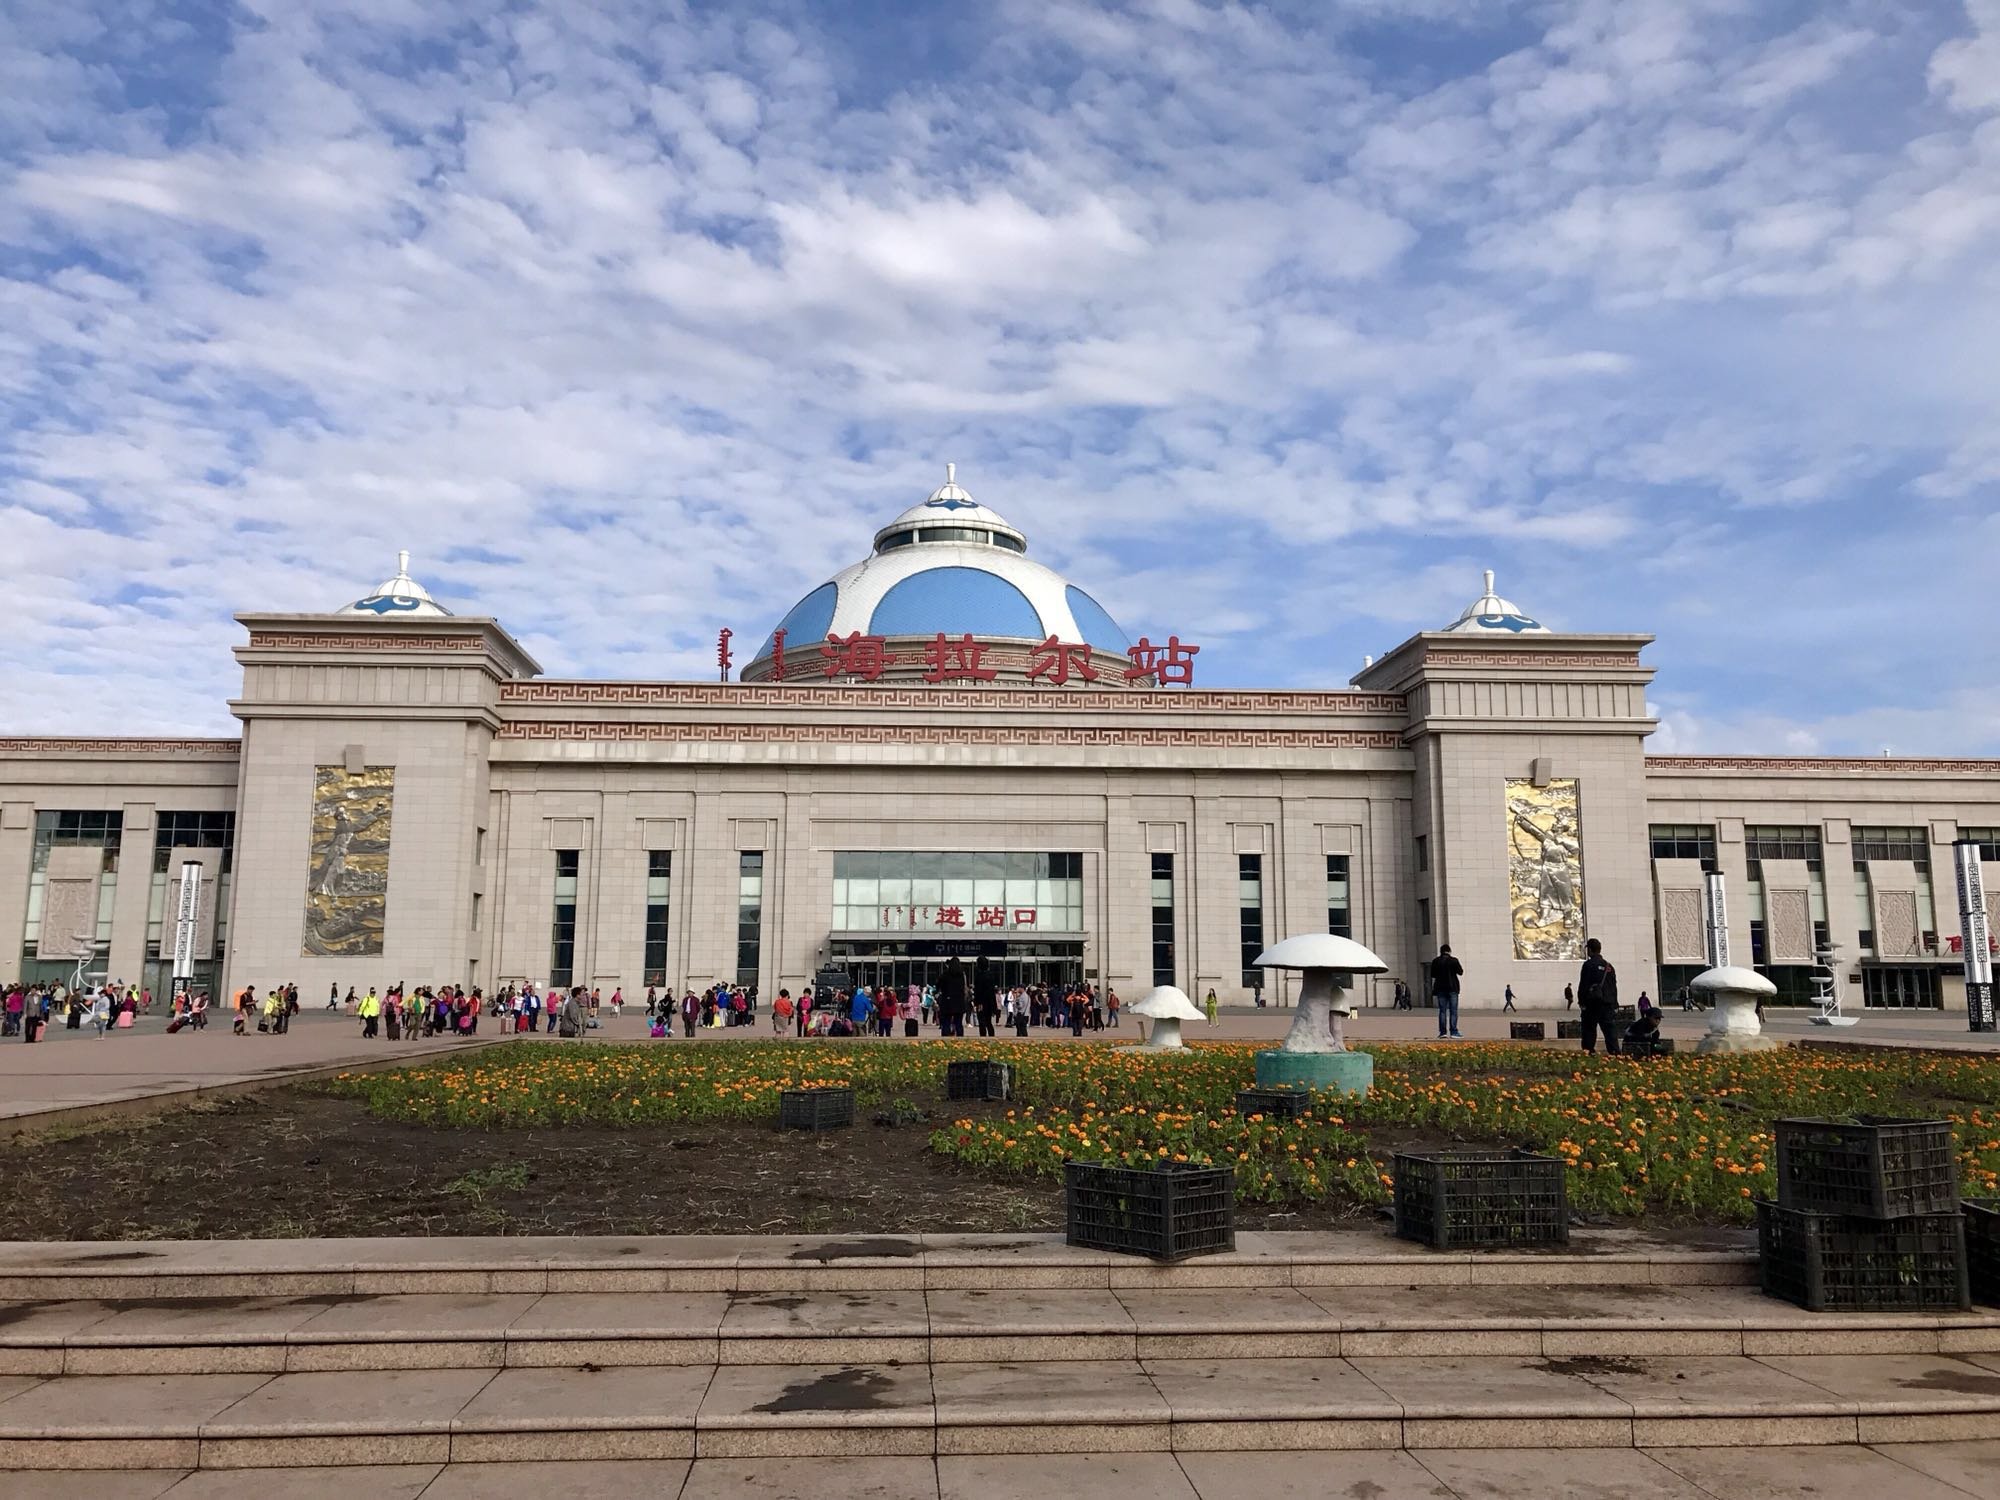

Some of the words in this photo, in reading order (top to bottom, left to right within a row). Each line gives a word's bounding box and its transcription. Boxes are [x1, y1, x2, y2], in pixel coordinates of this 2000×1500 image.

[821, 631, 1200, 684] 海拉尔站
[935, 906, 1036, 927] 进站口
